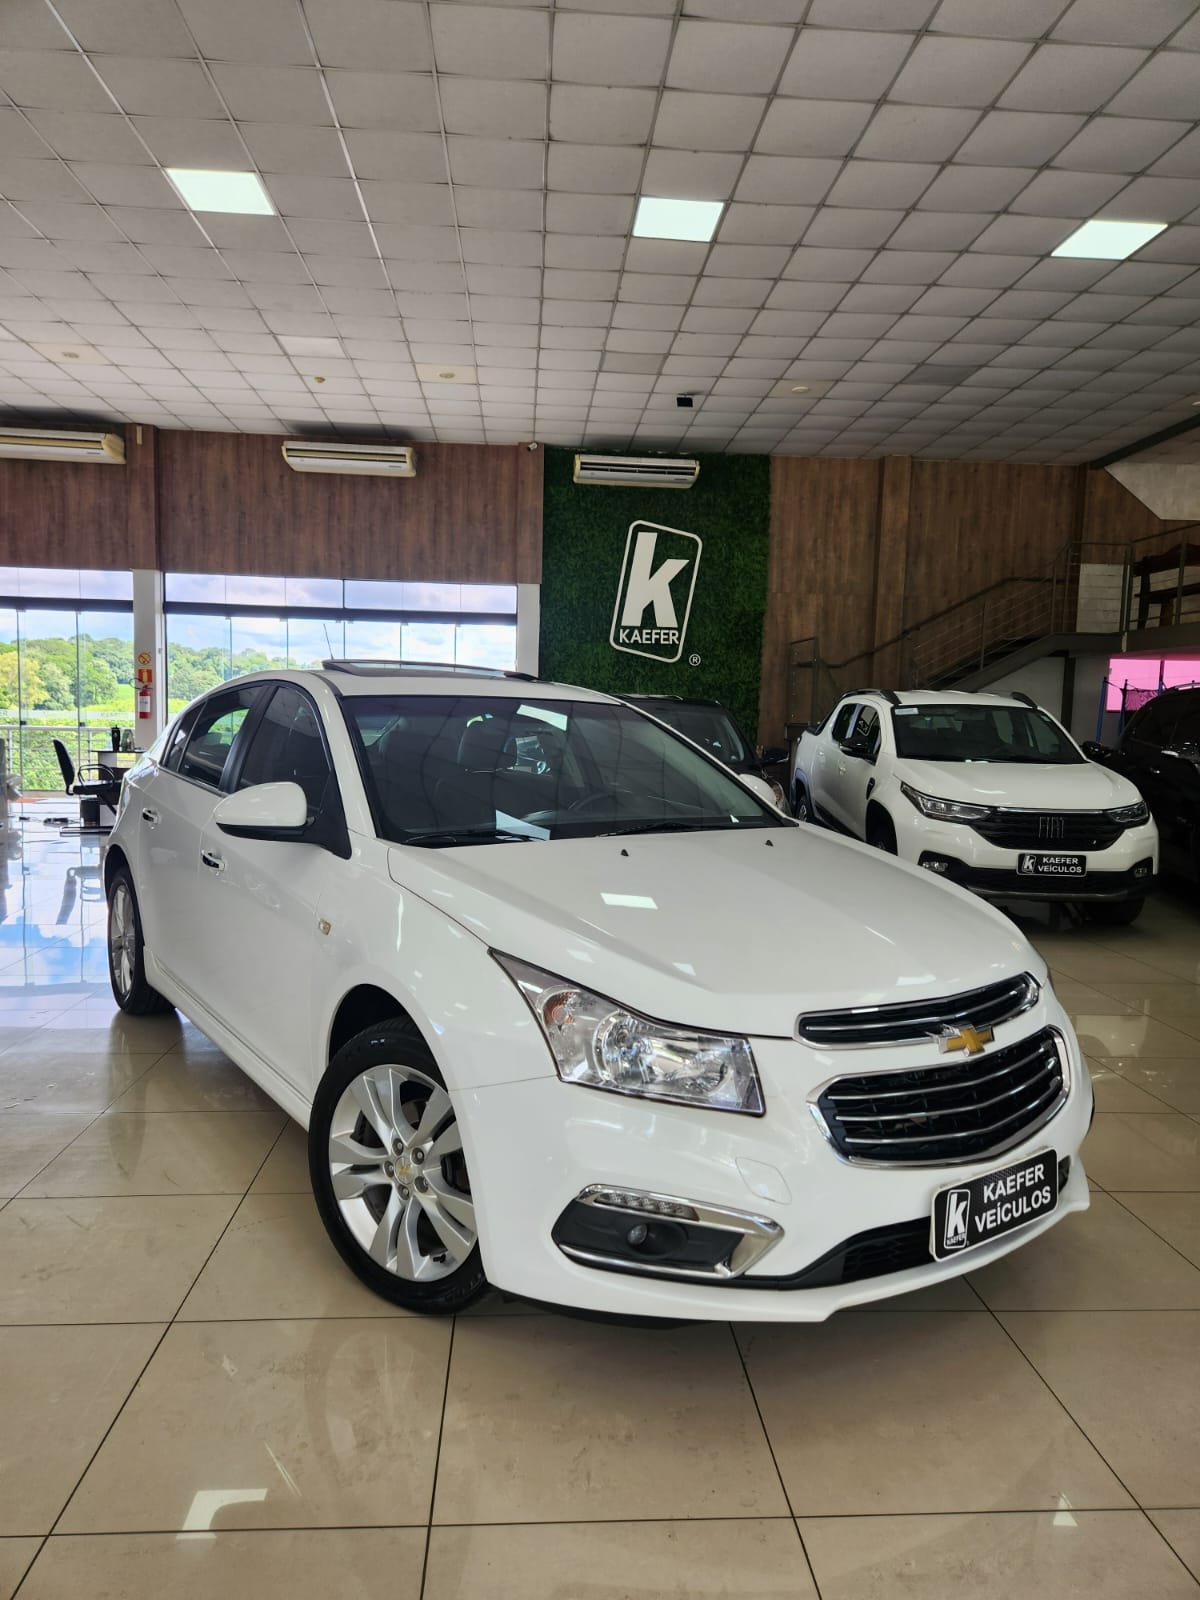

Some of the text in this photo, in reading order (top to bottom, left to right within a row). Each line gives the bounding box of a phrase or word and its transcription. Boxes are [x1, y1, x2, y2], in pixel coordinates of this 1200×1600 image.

[619, 629, 679, 644] KAEFER
[1038, 816, 1065, 839] FIAT
[1038, 864, 1082, 873] VEÍCULOS
[983, 1164, 1045, 1203] KAEFER
[974, 1186, 1051, 1233] VEÍCULOS
